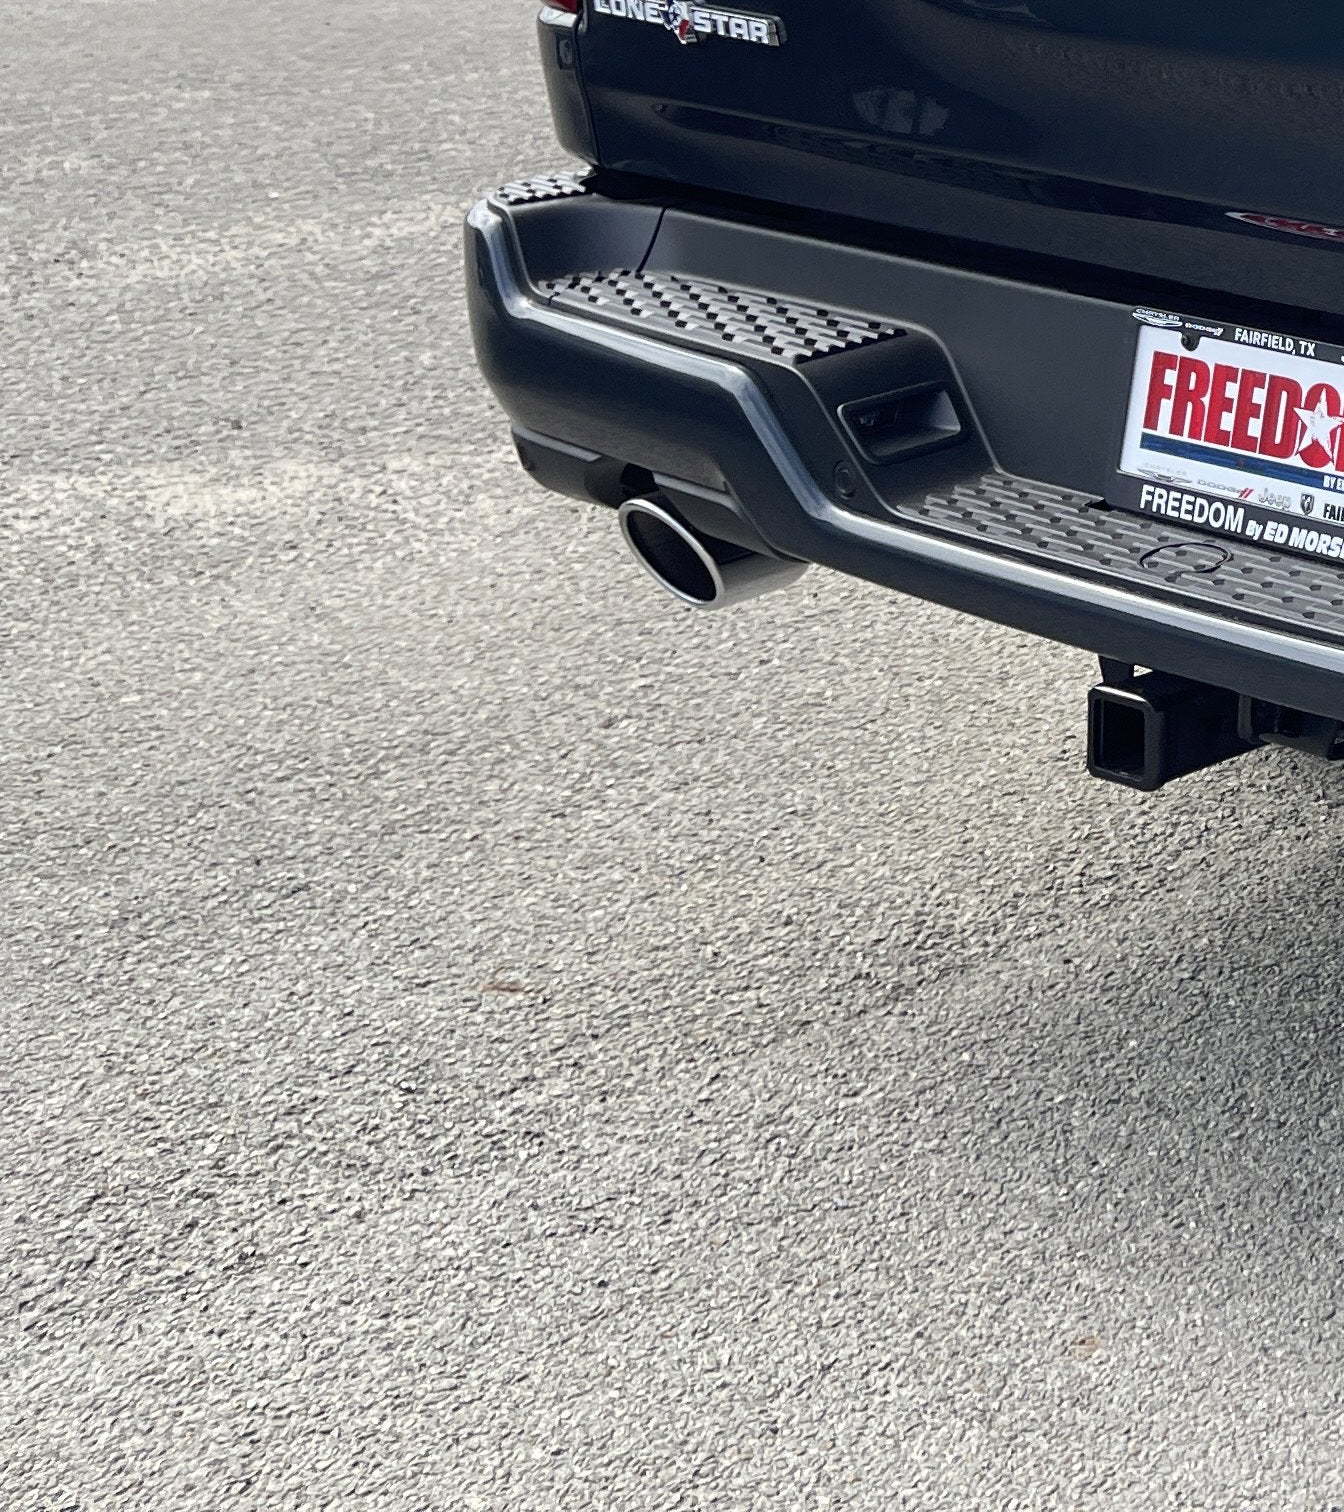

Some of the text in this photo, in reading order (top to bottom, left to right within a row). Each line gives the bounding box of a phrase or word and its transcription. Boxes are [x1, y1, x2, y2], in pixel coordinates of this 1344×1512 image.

[692, 9, 771, 45] STAR
[1234, 328, 1316, 357] FAIRFIELD, TX
[1322, 475, 1337, 489] BY
[1257, 488, 1292, 510] Jeep
[1140, 484, 1245, 534] FREEDOM
[1263, 521, 1289, 544] ED
